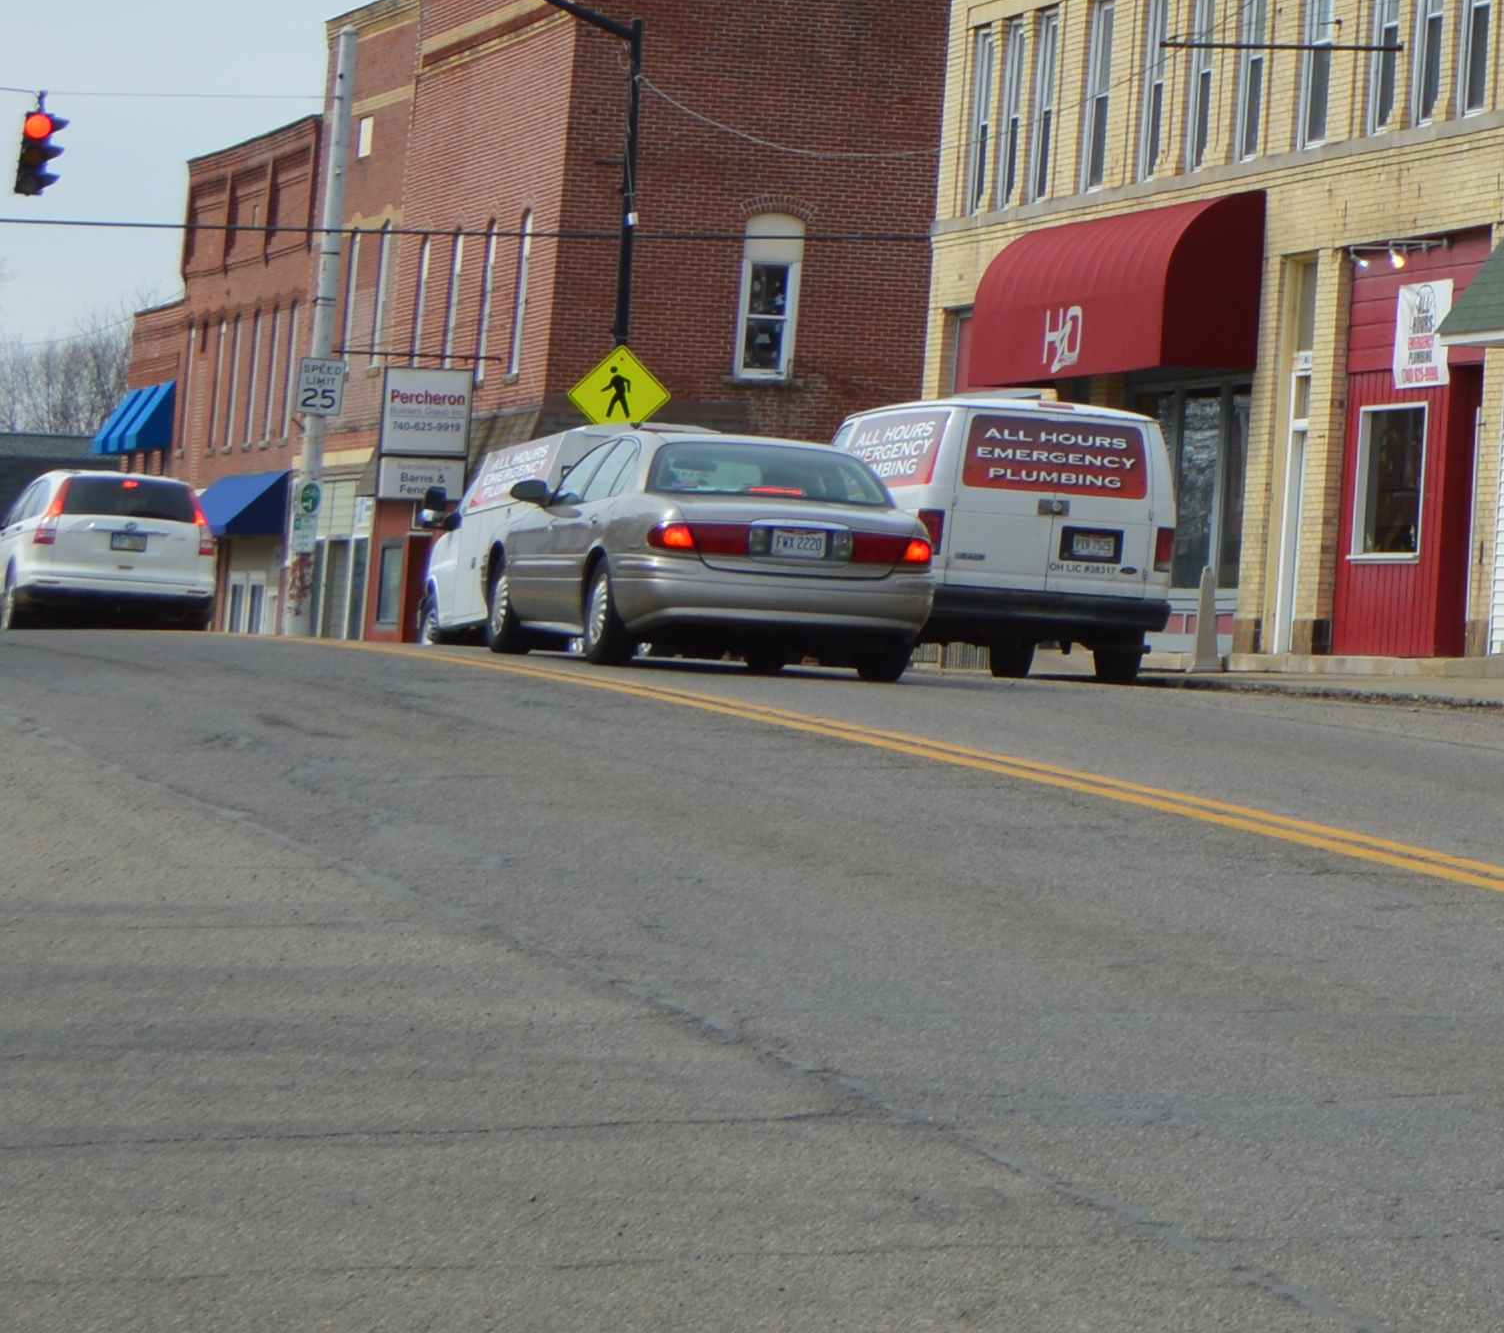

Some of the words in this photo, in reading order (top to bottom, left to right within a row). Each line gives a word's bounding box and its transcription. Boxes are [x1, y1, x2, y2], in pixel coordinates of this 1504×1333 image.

[303, 364, 342, 376] SPEED
[306, 376, 337, 386] LIMIT
[300, 387, 336, 409] 25
[390, 389, 466, 406] Percheron
[855, 431, 883, 449] ALL
[883, 420, 936, 442] HOURS
[984, 427, 1034, 443] ALL
[1039, 432, 1128, 450] HOURS
[491, 455, 510, 472] ALL
[513, 444, 550, 465] HOURS
[853, 438, 934, 462] MERGENCY
[976, 446, 1137, 470] EMERGENCY
[400, 473, 434, 483] Barns
[436, 473, 446, 483] &
[484, 458, 548, 483] EMERGENCY
[869, 458, 919, 478] MBING
[988, 467, 1122, 489] PLUMBING
[399, 484, 424, 494] Fenc
[776, 534, 794, 549] FWX
[797, 537, 822, 552] 2220
[1049, 562, 1064, 572] OH
